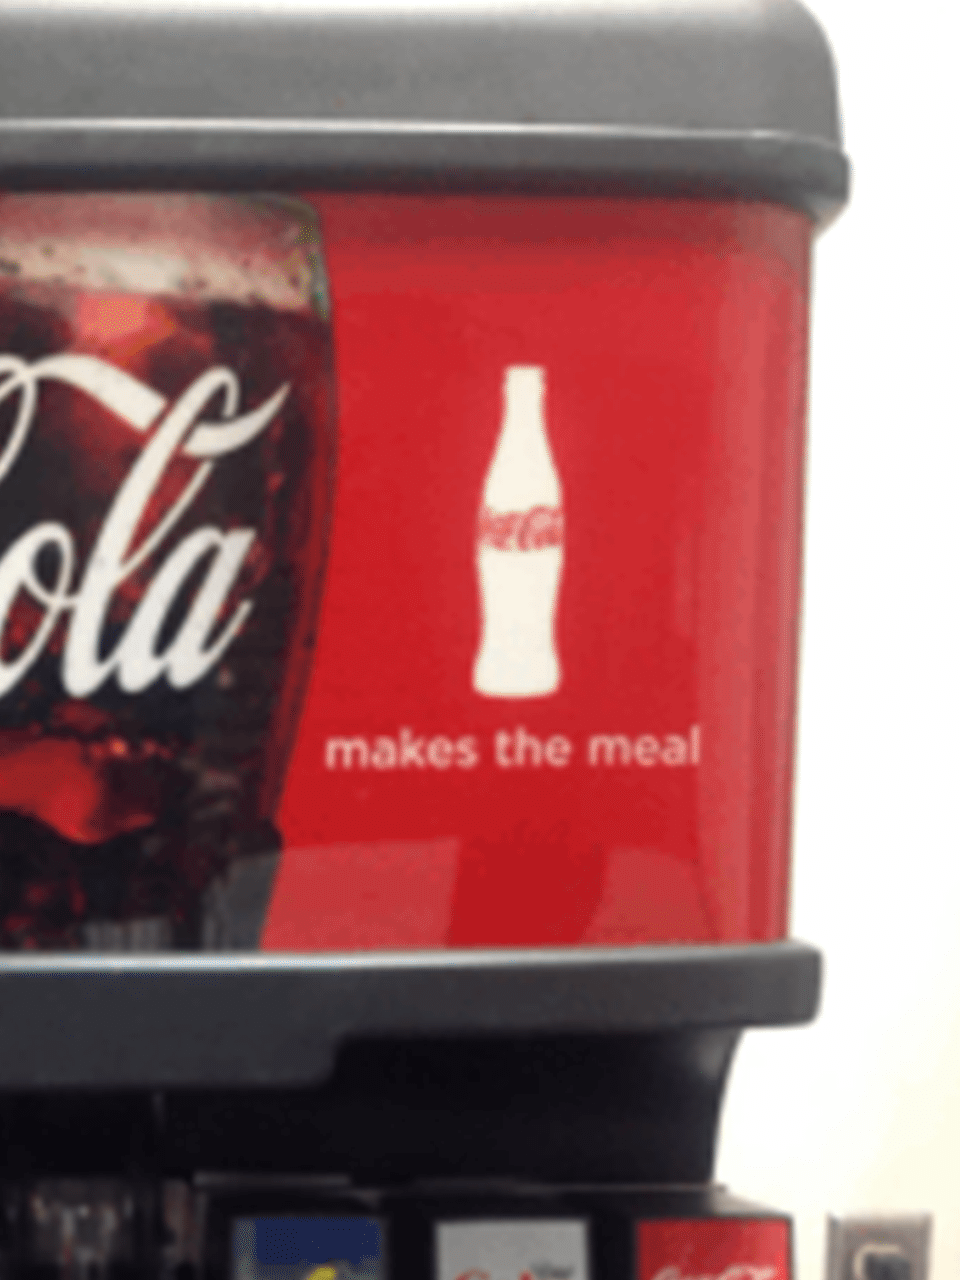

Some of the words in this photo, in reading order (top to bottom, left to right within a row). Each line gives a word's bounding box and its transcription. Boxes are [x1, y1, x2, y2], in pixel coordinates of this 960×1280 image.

[324, 726, 479, 770] makes
[494, 724, 573, 768] the
[587, 723, 701, 767] meal
